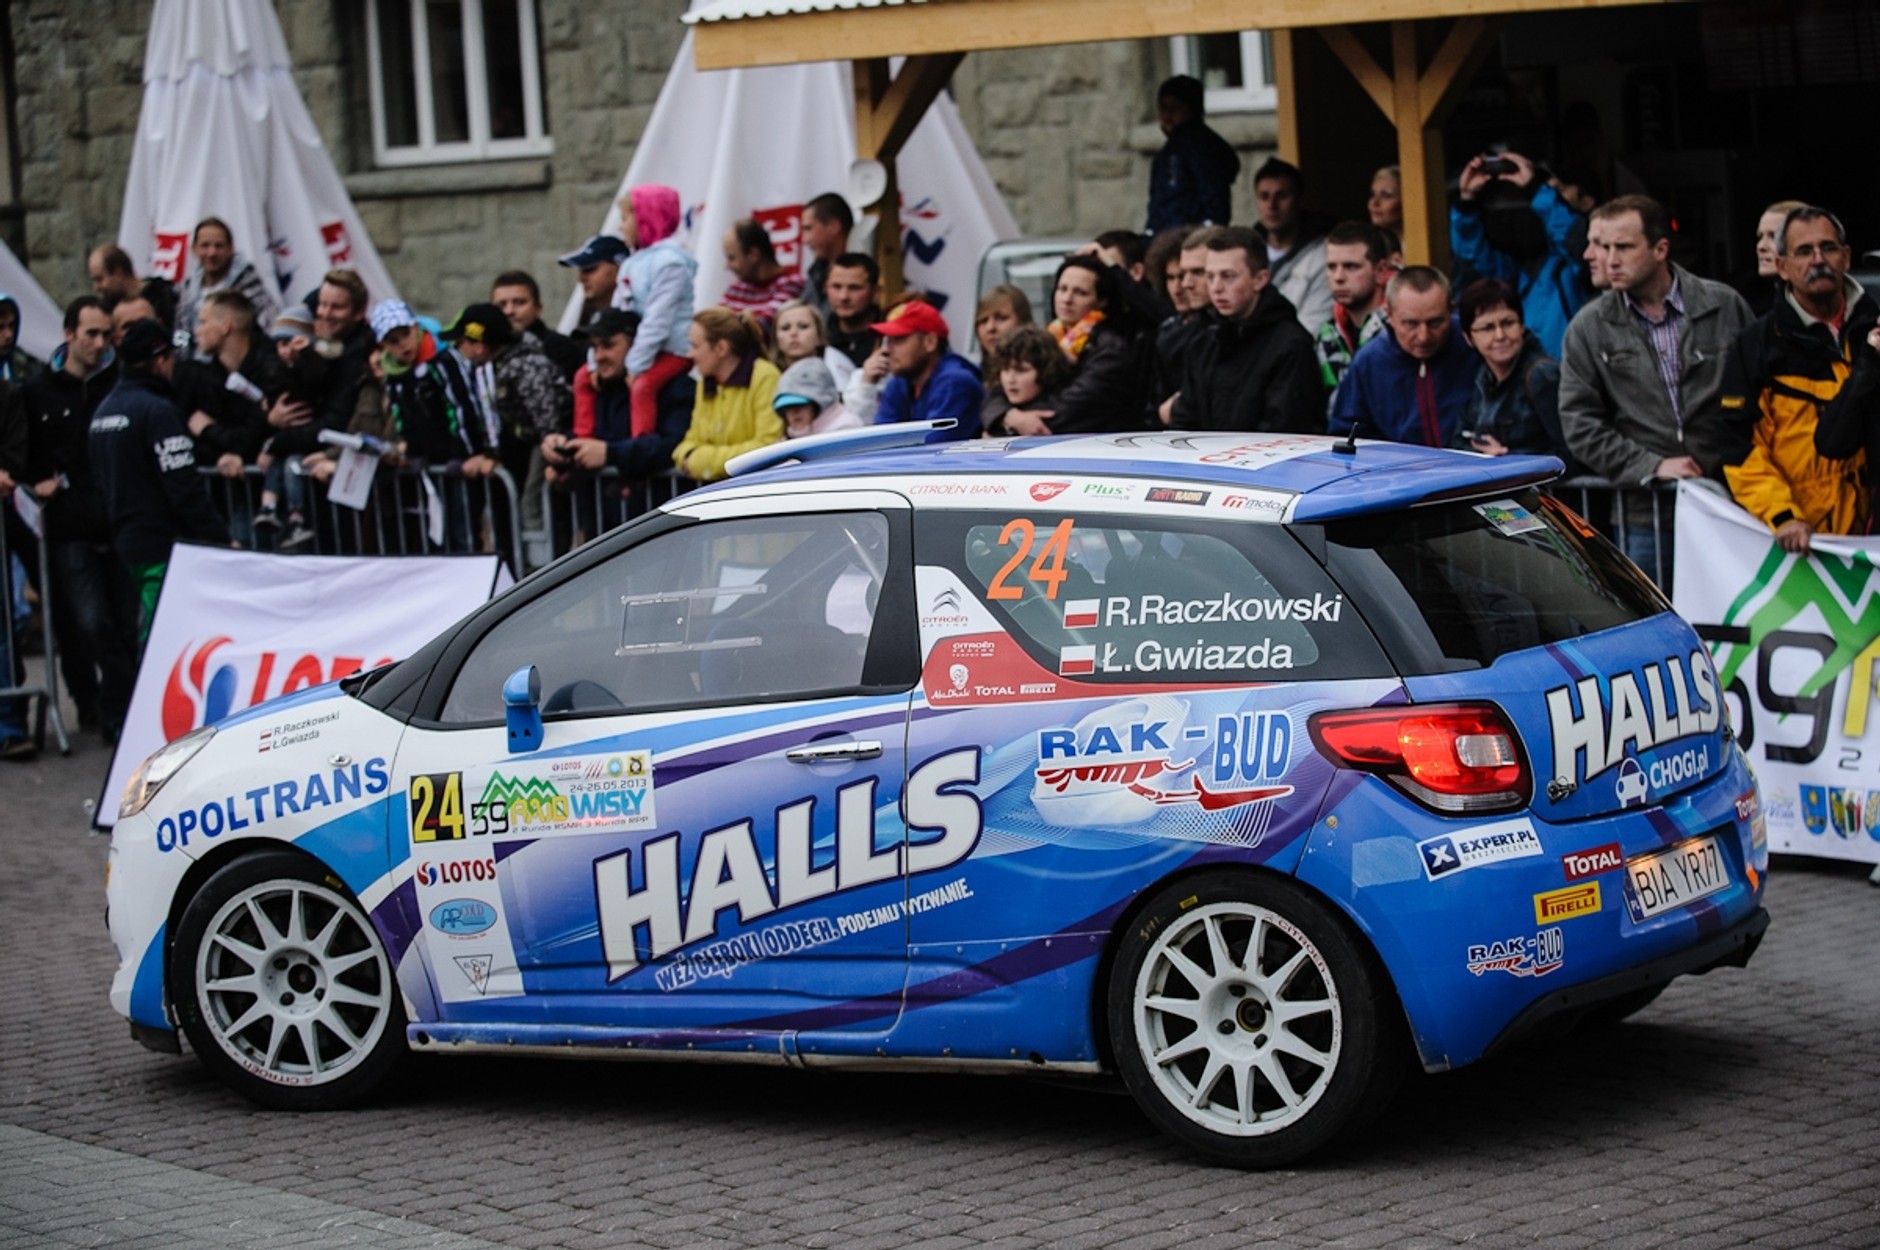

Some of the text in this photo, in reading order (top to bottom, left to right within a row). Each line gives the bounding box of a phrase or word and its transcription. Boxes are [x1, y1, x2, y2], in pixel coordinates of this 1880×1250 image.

[969, 485, 1010, 495] BANK
[1083, 484, 1124, 495] Plus
[985, 518, 1075, 600] 24
[1105, 592, 1343, 627] R.Raczkowski
[1101, 638, 1295, 673] Ł.Gwiazda
[974, 685, 1016, 696] TOTAL
[273, 711, 340, 736] R.Raczkowski
[1546, 650, 1720, 788] HALLS
[272, 730, 321, 750] Ł.Gwiazda
[1838, 746, 1862, 772] 2
[156, 757, 389, 854] OPOLTRANS
[411, 772, 464, 842] 24
[1459, 830, 1536, 854] EXPERT.PL
[440, 858, 497, 884] LOTOS
[594, 744, 983, 984] HALLS
[1564, 850, 1622, 876] TOTAL
[1635, 843, 1722, 911] BIA YR77
[762, 918, 839, 956] ODDECH.
[899, 877, 975, 916] WYZWANIE.
[1541, 887, 1597, 918] PIRELLI
